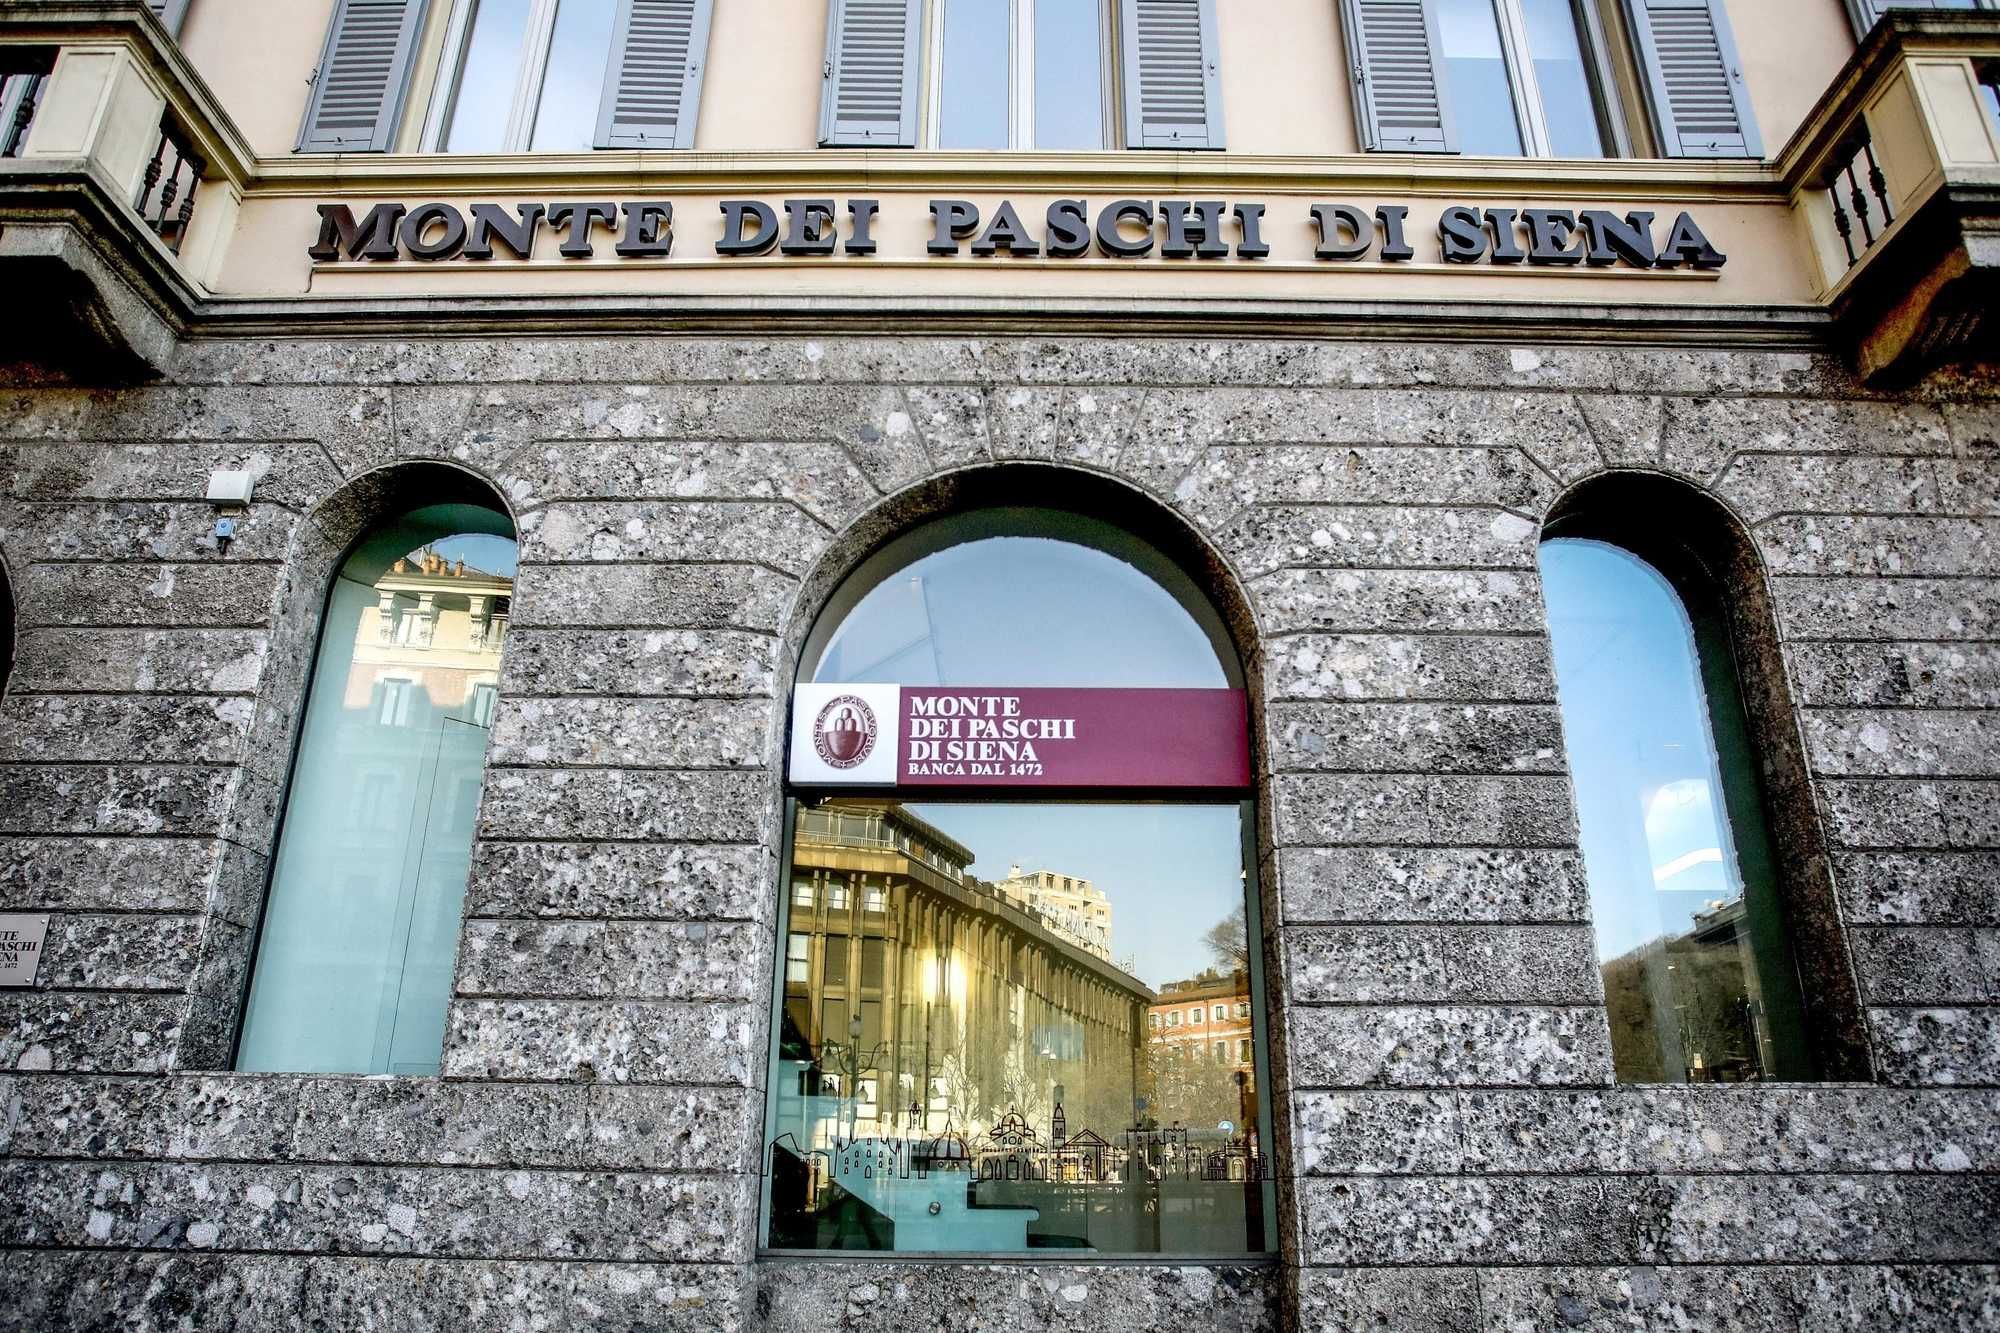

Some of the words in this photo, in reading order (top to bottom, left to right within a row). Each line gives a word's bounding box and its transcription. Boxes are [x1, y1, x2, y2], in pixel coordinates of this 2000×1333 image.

[308, 203, 673, 258] MONTE
[715, 200, 879, 256] DEI
[927, 200, 1270, 258] PASCHI
[1310, 203, 1414, 261] DI
[1438, 206, 1727, 269] SIENA
[910, 696, 1020, 717] MONTE
[909, 718, 962, 738] DEI
[967, 718, 1076, 739] PASCHI
[908, 740, 941, 761] DI
[946, 740, 1038, 761] SIENA
[908, 763, 966, 775] BANCA
[970, 763, 1005, 775] DAL
[1009, 763, 1043, 776] 1472
